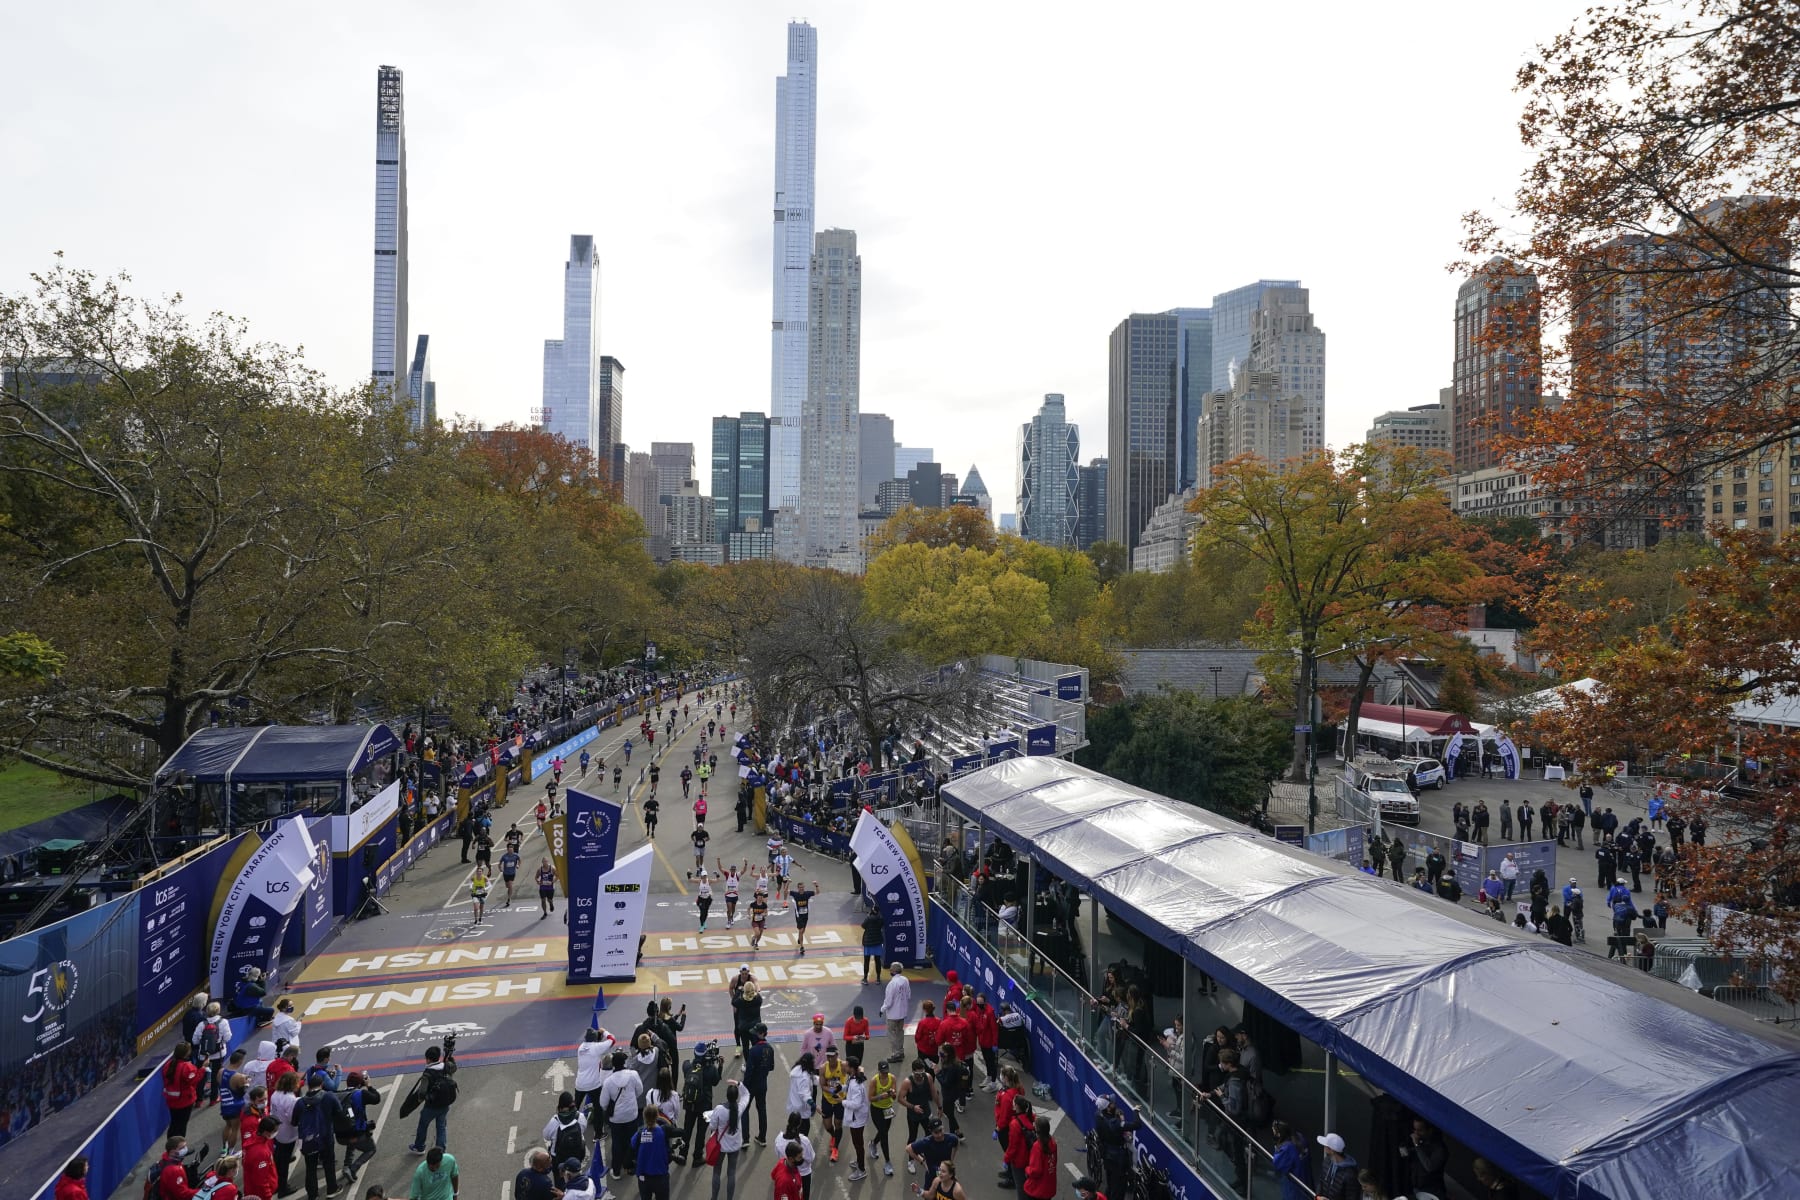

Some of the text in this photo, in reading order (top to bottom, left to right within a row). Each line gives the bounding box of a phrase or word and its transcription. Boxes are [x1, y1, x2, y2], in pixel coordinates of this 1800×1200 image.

[553, 824, 564, 856] 2021
[871, 863, 888, 875] tcs
[155, 889, 168, 906] tcs
[266, 881, 290, 893] tcs
[873, 826, 925, 944] TCS NEW YORK CITY MARATHON
[210, 833, 285, 975] TCS NEW YORK CITY MARATHON
[577, 897, 592, 907] tcs
[660, 931, 842, 951] FINISH
[946, 924, 957, 951] tcs
[337, 944, 547, 973] FINISH
[668, 961, 866, 986] FINISH
[304, 978, 542, 1016] FINISH
[154, 1021, 167, 1036] YEARS
